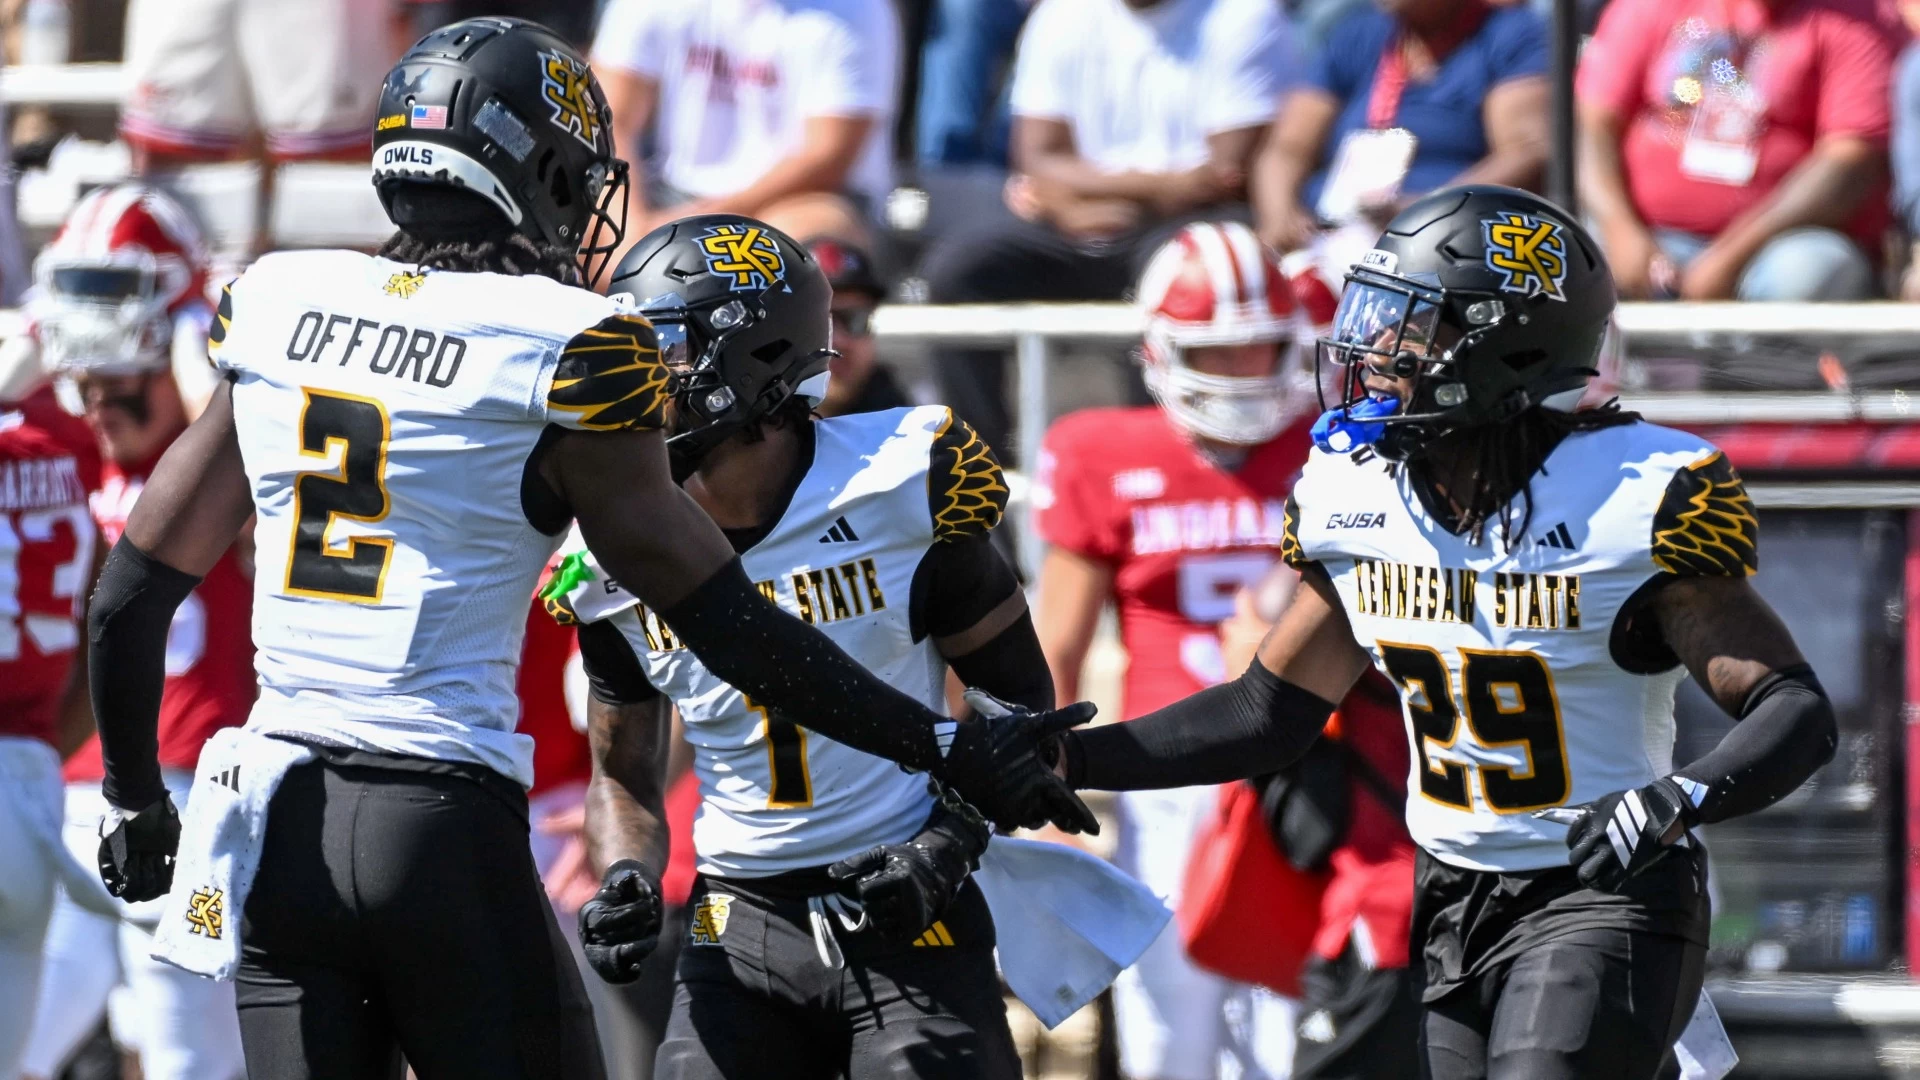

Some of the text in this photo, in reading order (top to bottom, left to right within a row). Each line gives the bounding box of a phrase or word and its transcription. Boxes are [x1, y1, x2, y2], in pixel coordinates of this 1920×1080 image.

[385, 146, 433, 165] OWLS
[286, 311, 467, 389] OFFORD
[283, 386, 395, 605] 2
[791, 558, 886, 625] STATE
[1354, 559, 1581, 630] KENNESAW STATE
[1376, 639, 1572, 815] 29
